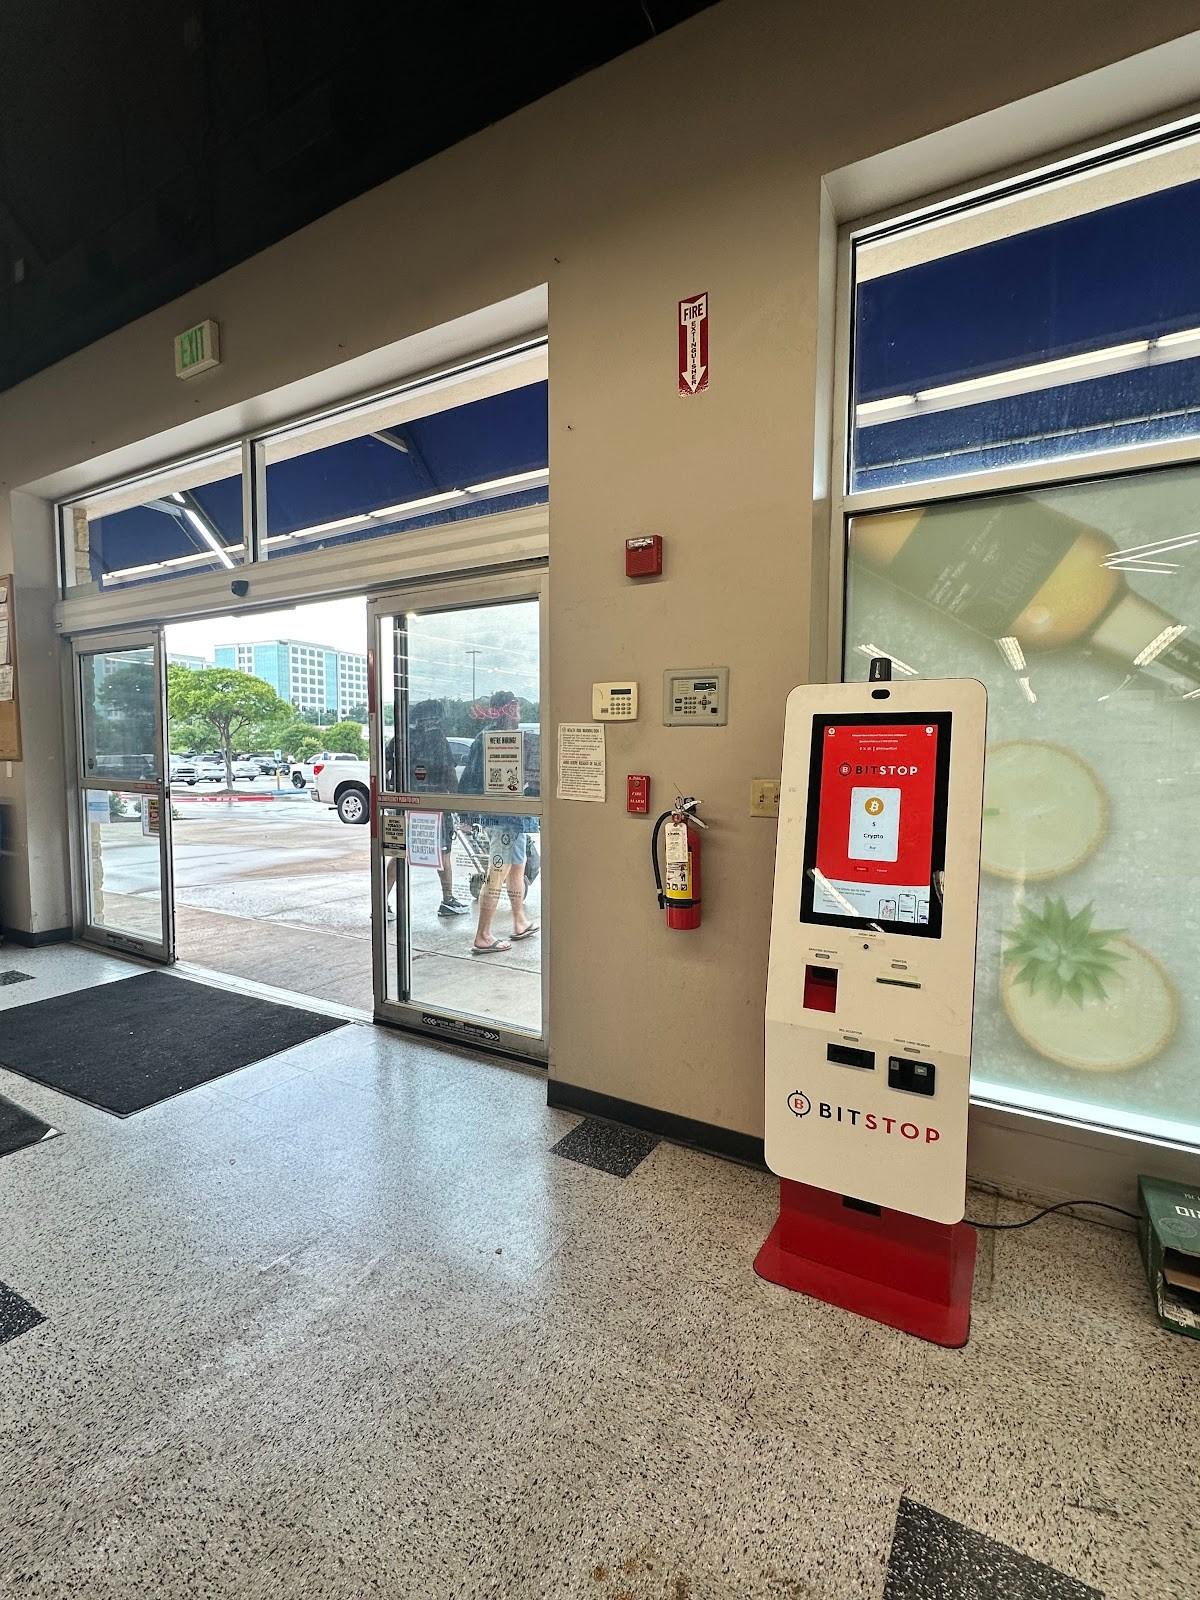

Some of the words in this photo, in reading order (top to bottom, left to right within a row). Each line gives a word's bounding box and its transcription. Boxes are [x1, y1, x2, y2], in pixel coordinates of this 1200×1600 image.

[683, 303, 704, 322] FIRE
[180, 326, 205, 368] EXIT
[489, 736, 502, 745] WE'RE
[855, 765, 918, 776] BITSTOP
[863, 832, 884, 840] Crypto
[819, 1102, 941, 1144] BITSTOP
